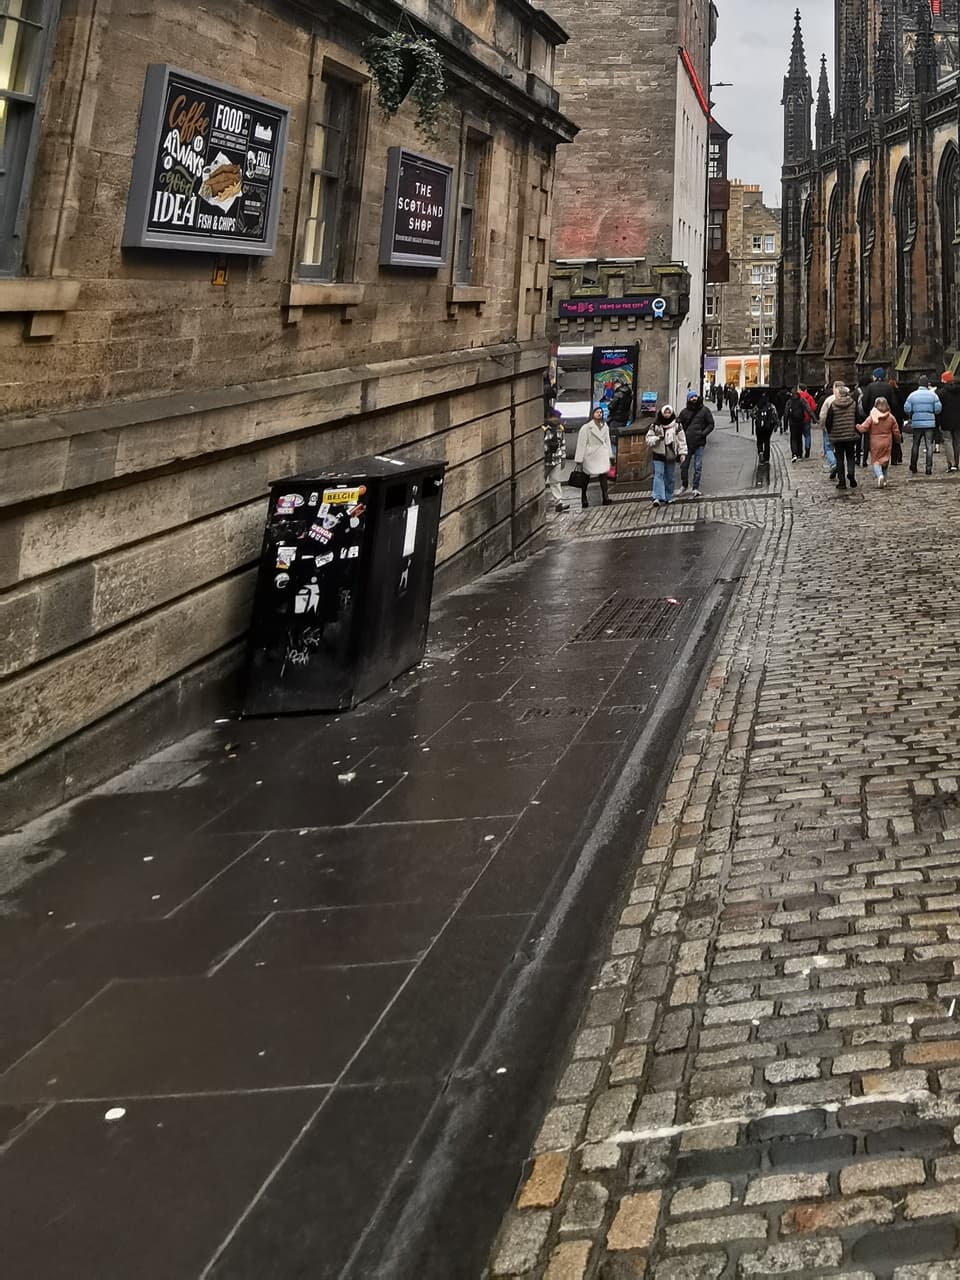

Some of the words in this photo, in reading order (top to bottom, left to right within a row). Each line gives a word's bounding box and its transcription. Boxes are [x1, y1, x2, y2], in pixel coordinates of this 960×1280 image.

[168, 94, 210, 143] Coffee
[214, 104, 244, 134] FOOD
[163, 128, 206, 178] ALWAYS
[159, 166, 197, 198] good
[415, 182, 432, 198] THE
[152, 191, 198, 227] IDEA
[198, 213, 213, 228] FISH
[212, 216, 219, 230] &
[218, 216, 237, 232] CHIPS
[398, 197, 443, 218] SCOTLAND
[408, 217, 432, 232] SHOP
